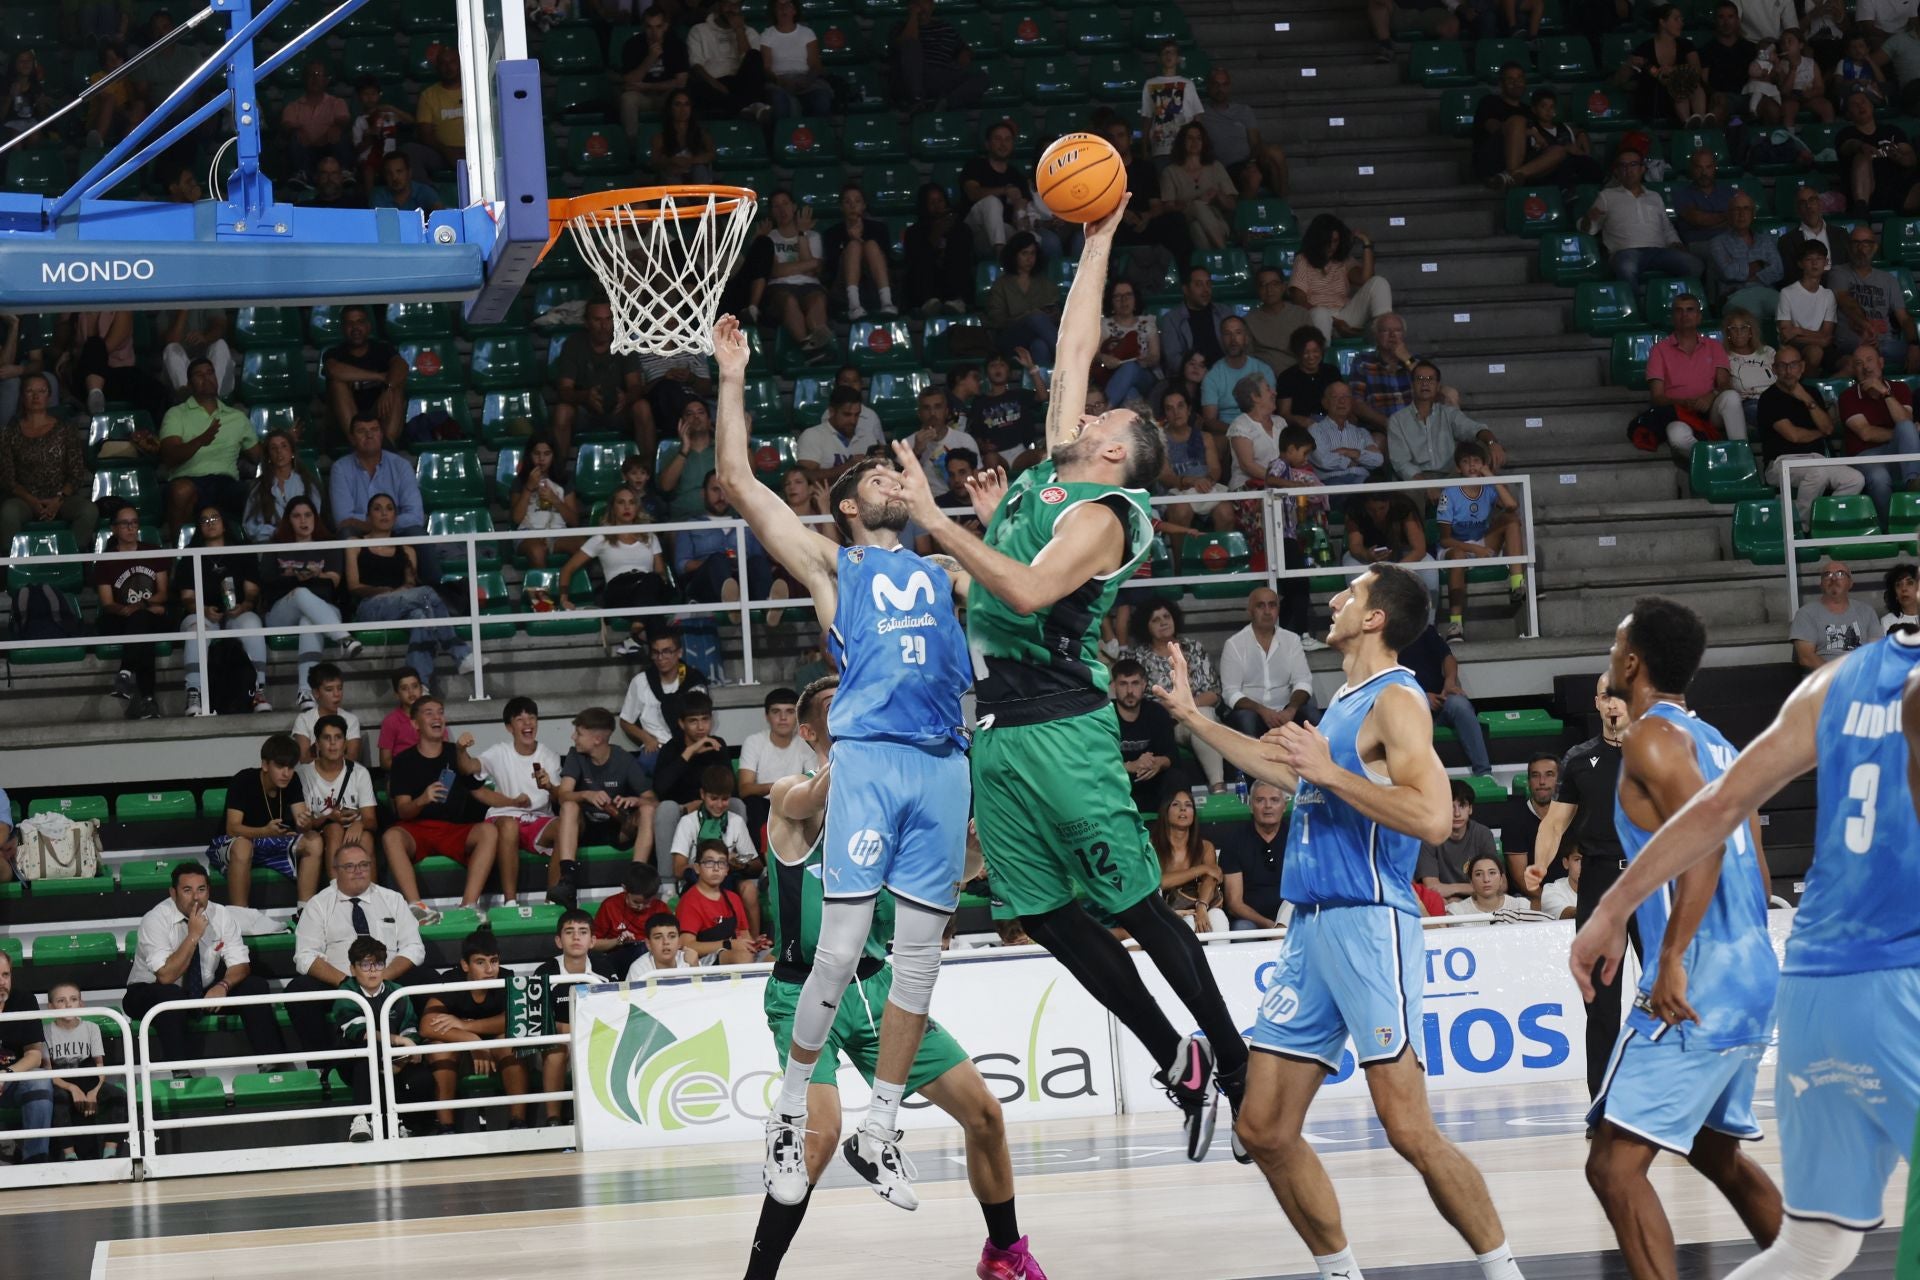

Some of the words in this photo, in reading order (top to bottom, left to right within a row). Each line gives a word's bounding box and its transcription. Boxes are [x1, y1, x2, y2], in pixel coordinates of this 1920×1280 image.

[42, 260, 154, 283] MONDO
[900, 635, 925, 665] 29
[1845, 763, 1880, 854] 3
[1302, 812, 1309, 844] 1
[851, 830, 881, 866] hp
[1073, 841, 1118, 879] 12
[1264, 985, 1297, 1021] hp
